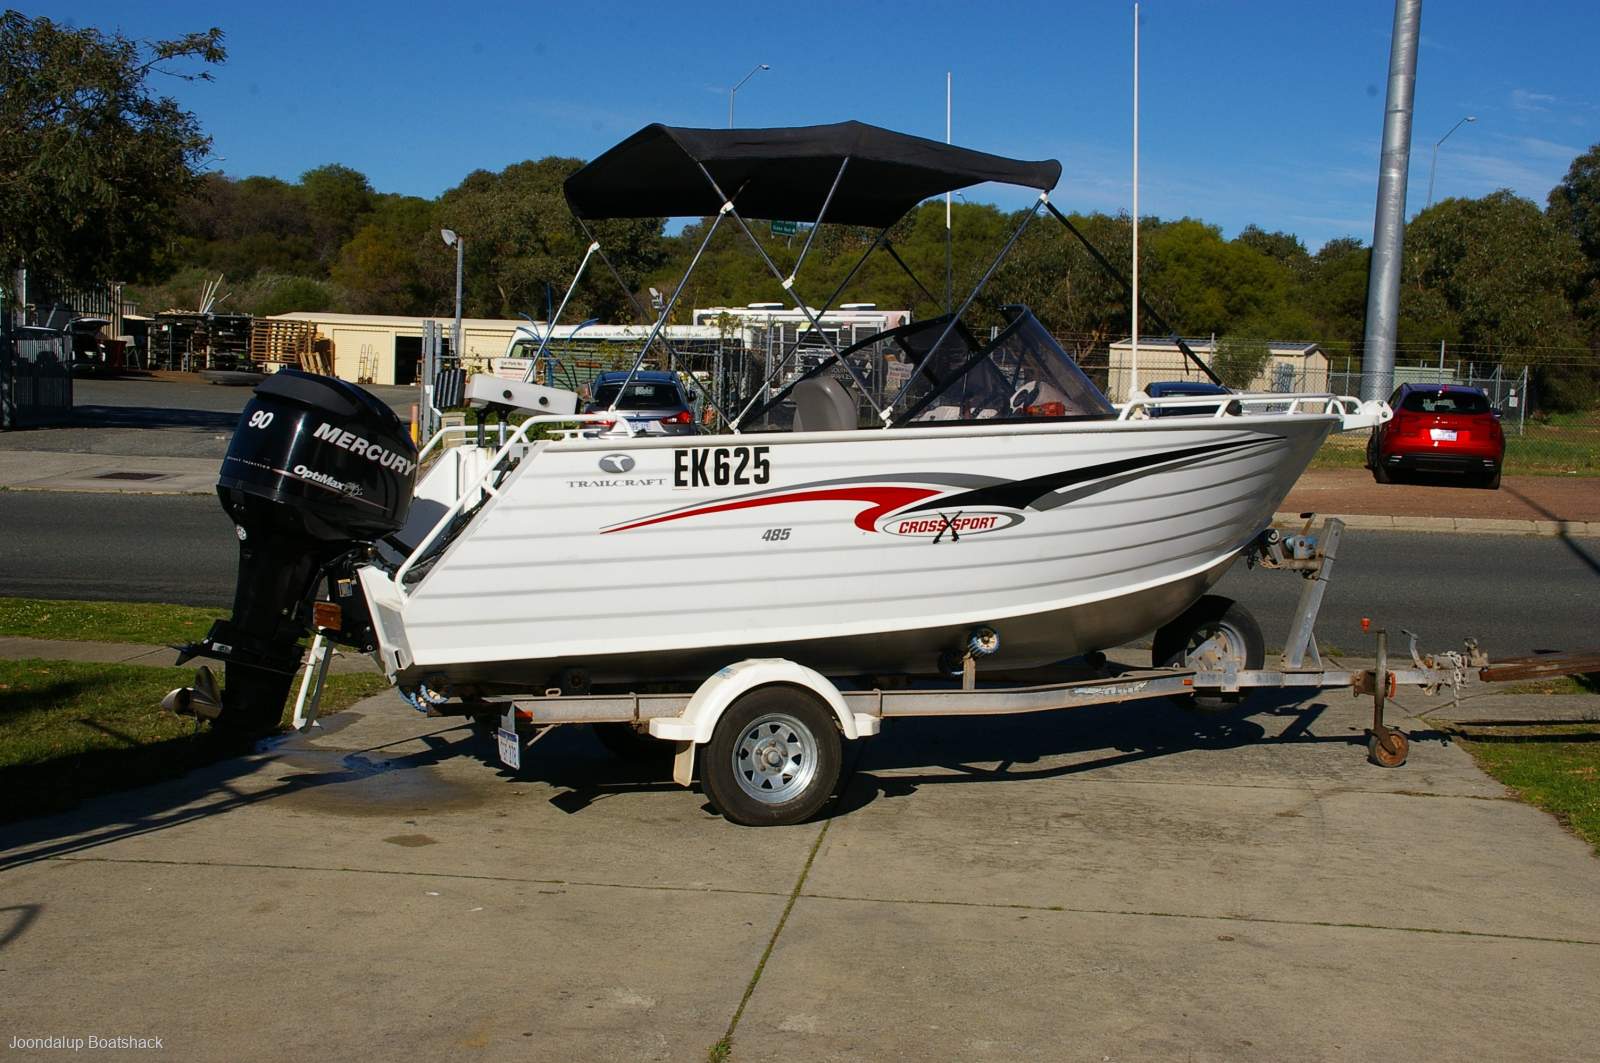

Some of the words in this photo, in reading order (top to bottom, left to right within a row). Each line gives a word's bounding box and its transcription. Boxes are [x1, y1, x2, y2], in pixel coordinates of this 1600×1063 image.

[249, 410, 274, 429] 90
[313, 422, 416, 477] MERCURY
[293, 464, 345, 490] OptiMax
[674, 446, 770, 487] EK625
[566, 478, 667, 488] TRAILCRAFT
[761, 527, 792, 541] 485
